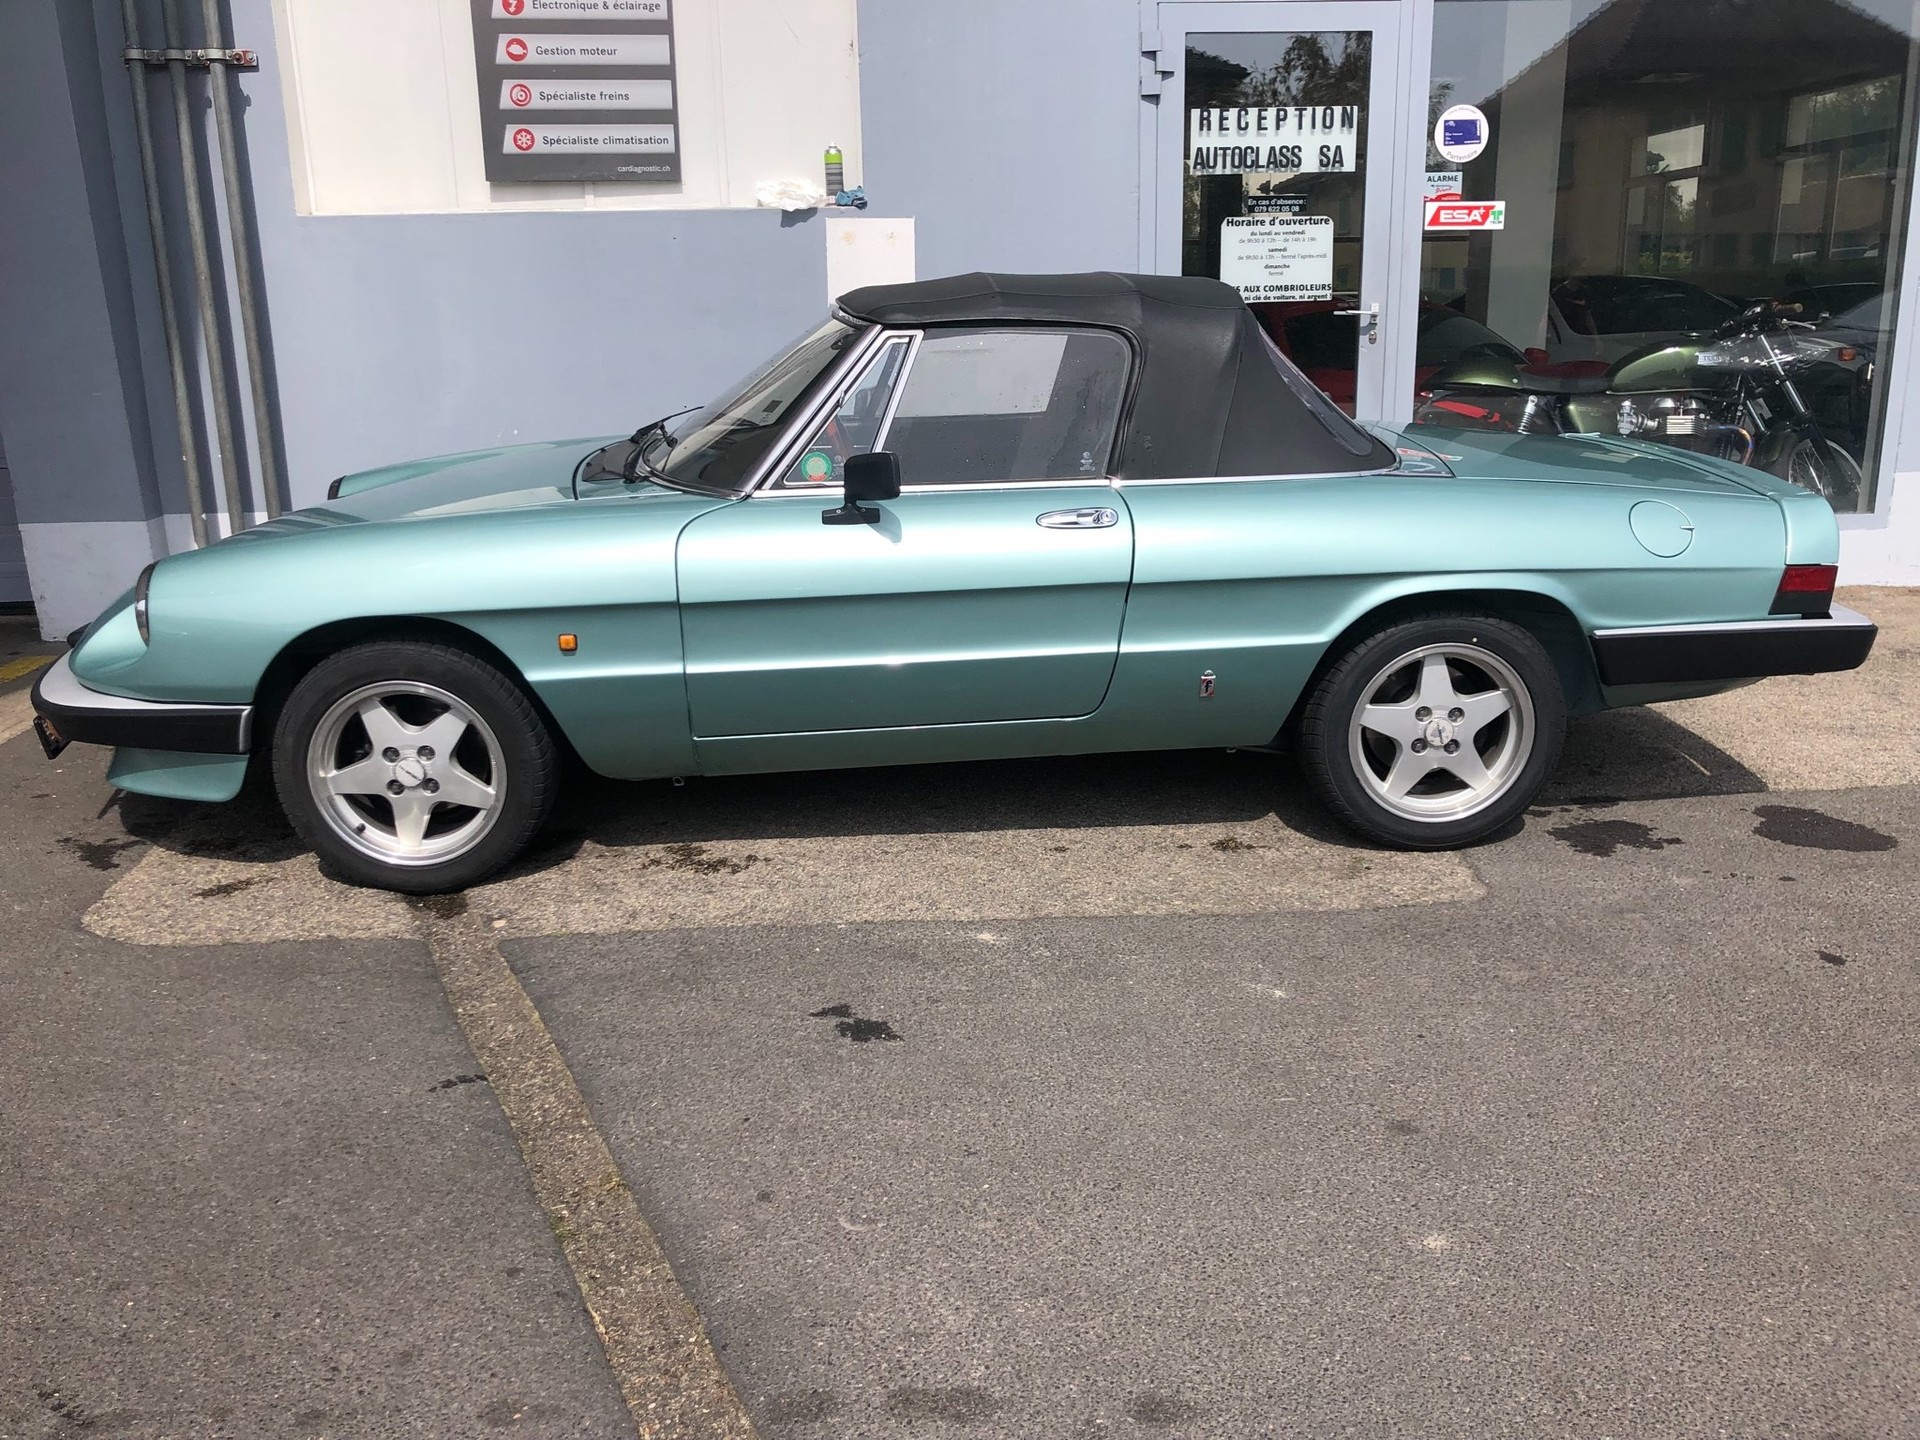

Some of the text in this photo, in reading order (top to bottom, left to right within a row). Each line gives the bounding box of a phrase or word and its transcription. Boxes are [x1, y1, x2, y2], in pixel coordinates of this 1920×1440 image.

[602, 1, 609, 10] &
[613, 0, 661, 12] éclairage
[535, 46, 618, 56] Gestion moteur
[539, 91, 630, 103] Spécialiste freins
[1199, 106, 1354, 131] RECEPTION
[542, 134, 669, 147] Spécialiste climatisation
[1193, 144, 1344, 170] AUTOCLASS SA
[1446, 150, 1478, 161] Partenaire
[617, 164, 671, 174] cardiagnostic.ch
[1426, 174, 1459, 183] ALARME
[1226, 216, 1330, 227] Horaire d'ouverture
[1243, 285, 1261, 293] AUX
[1263, 283, 1332, 292] COMBRIOLEURS
[1263, 293, 1271, 301] de
